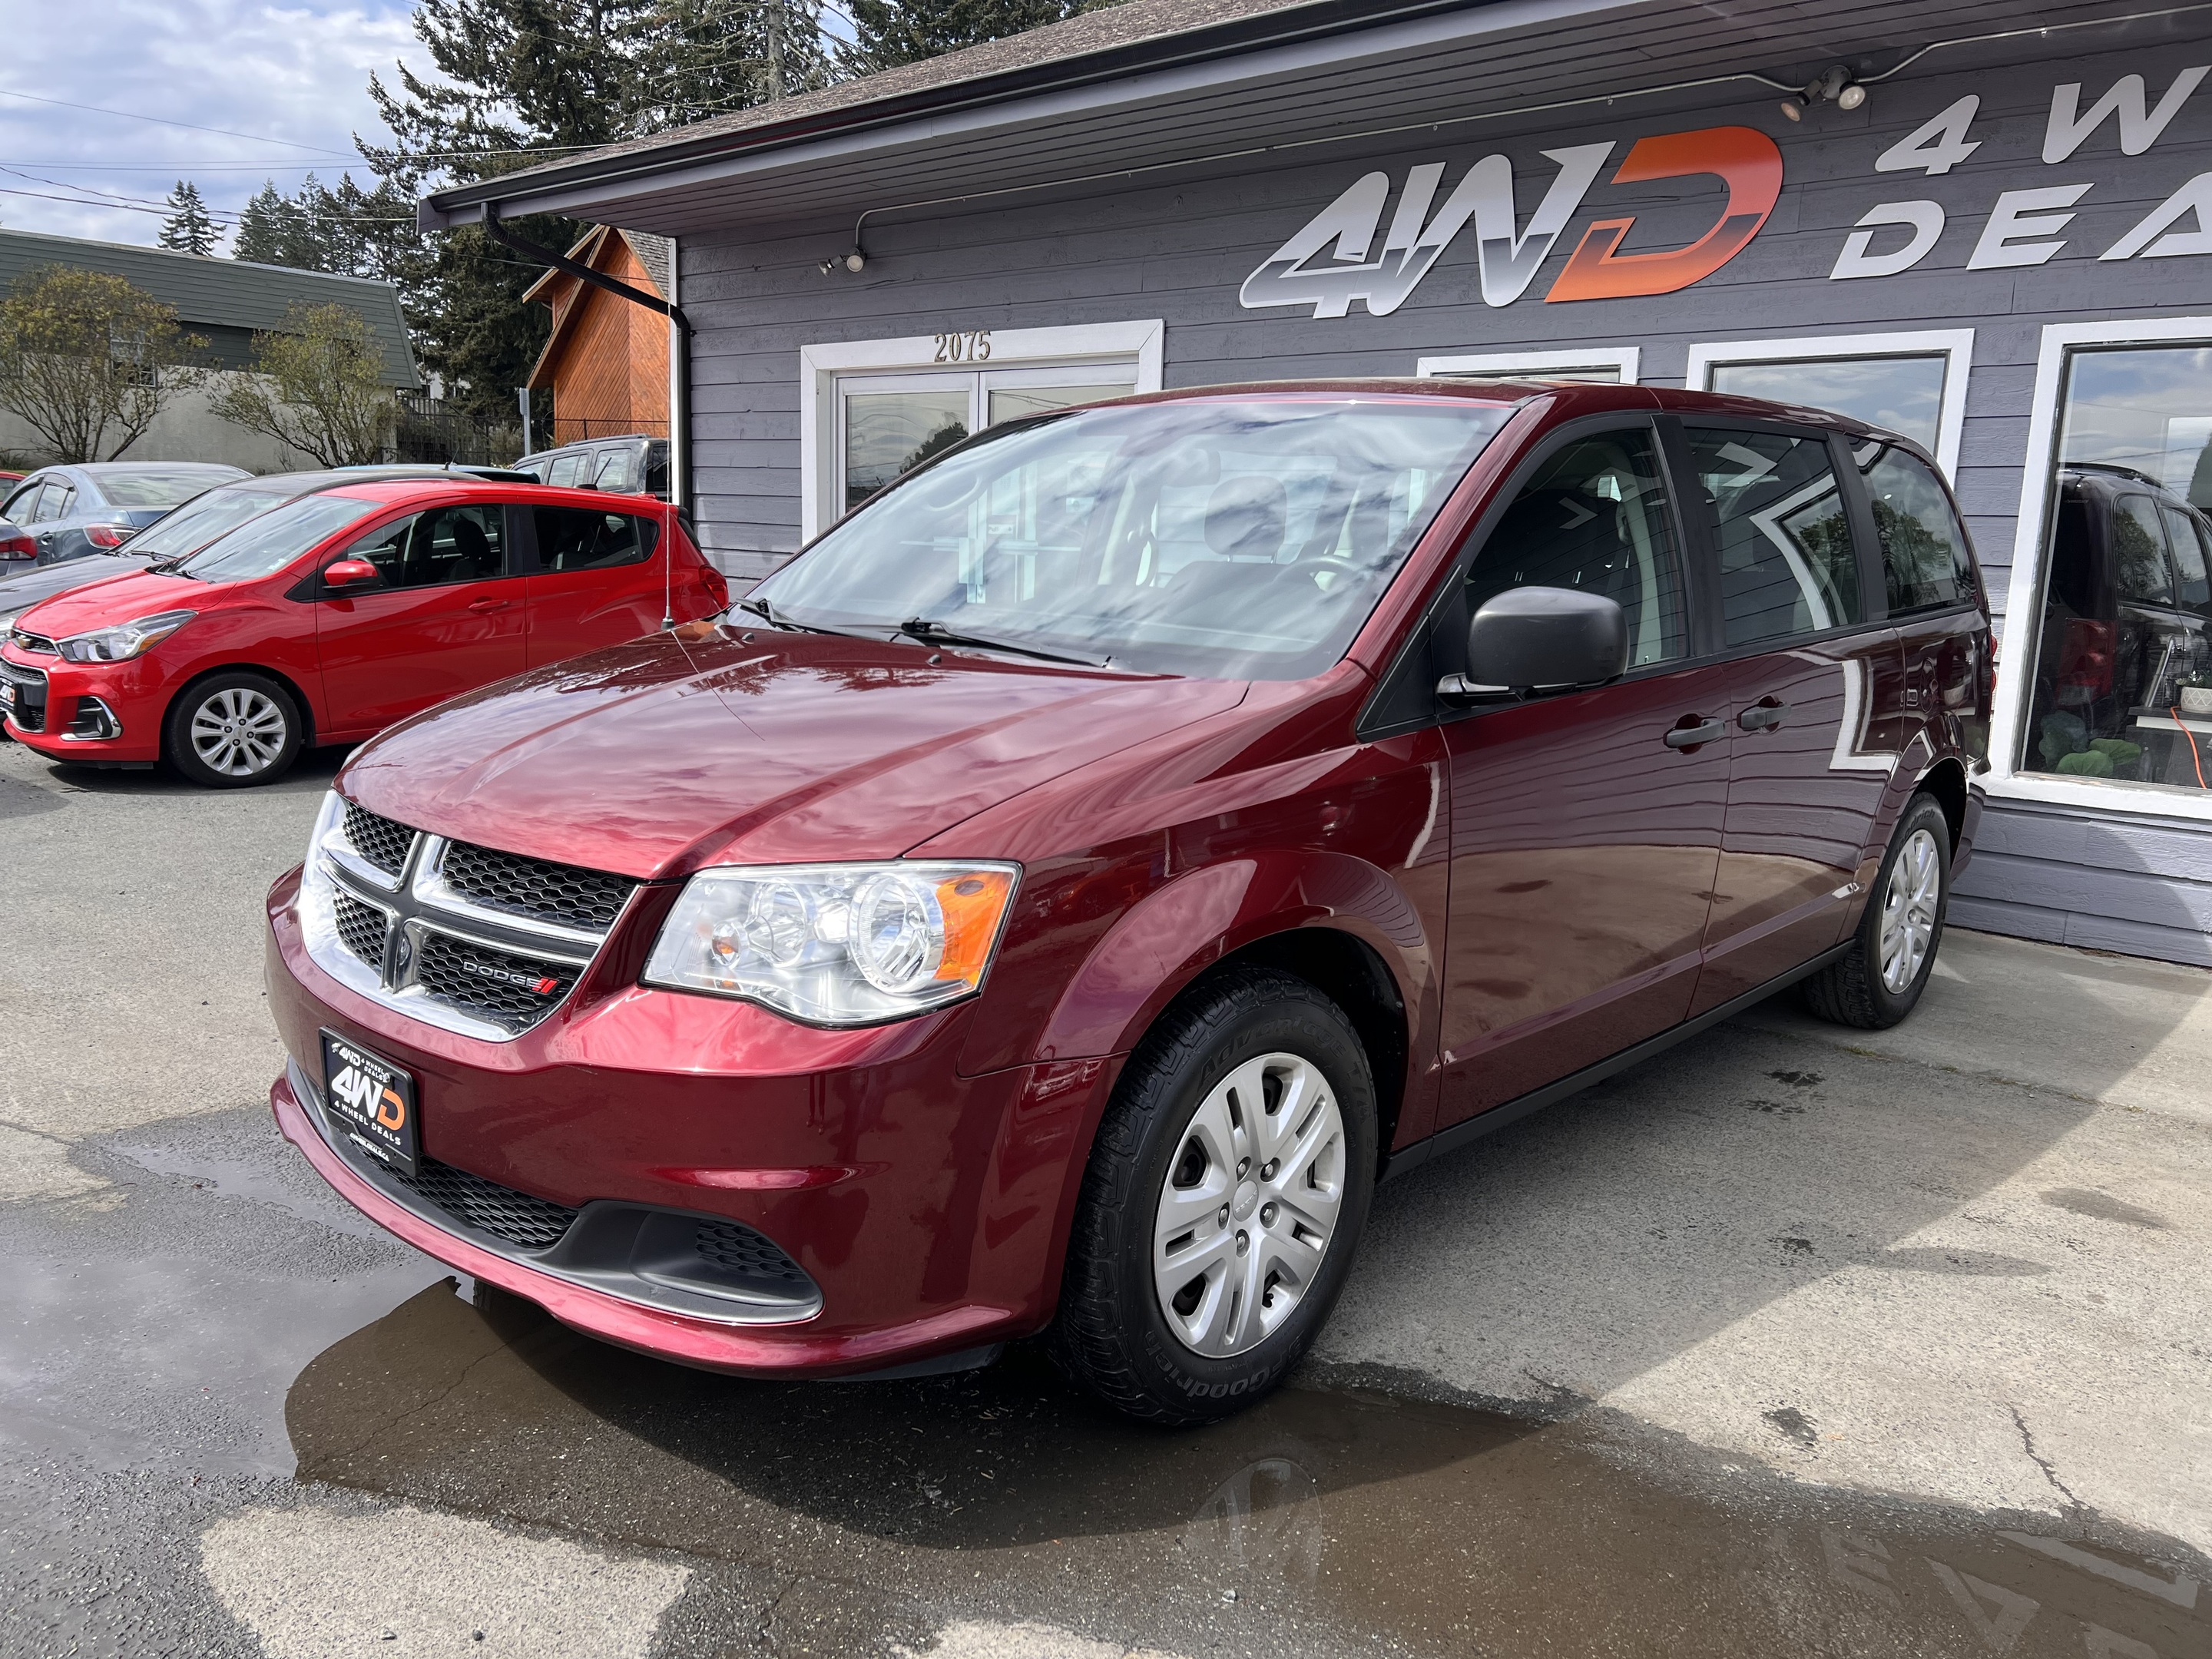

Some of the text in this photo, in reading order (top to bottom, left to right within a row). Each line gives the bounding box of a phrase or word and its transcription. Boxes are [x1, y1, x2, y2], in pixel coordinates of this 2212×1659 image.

[1875, 94, 1983, 175] 4
[1239, 124, 1784, 320] 4WD
[934, 329, 991, 363] 2075
[462, 961, 542, 990] DODGE
[339, 1047, 361, 1067] 4WD
[331, 1065, 406, 1131] 4WD
[341, 1103, 369, 1126] WHEEL
[371, 1119, 402, 1147] DEALS
